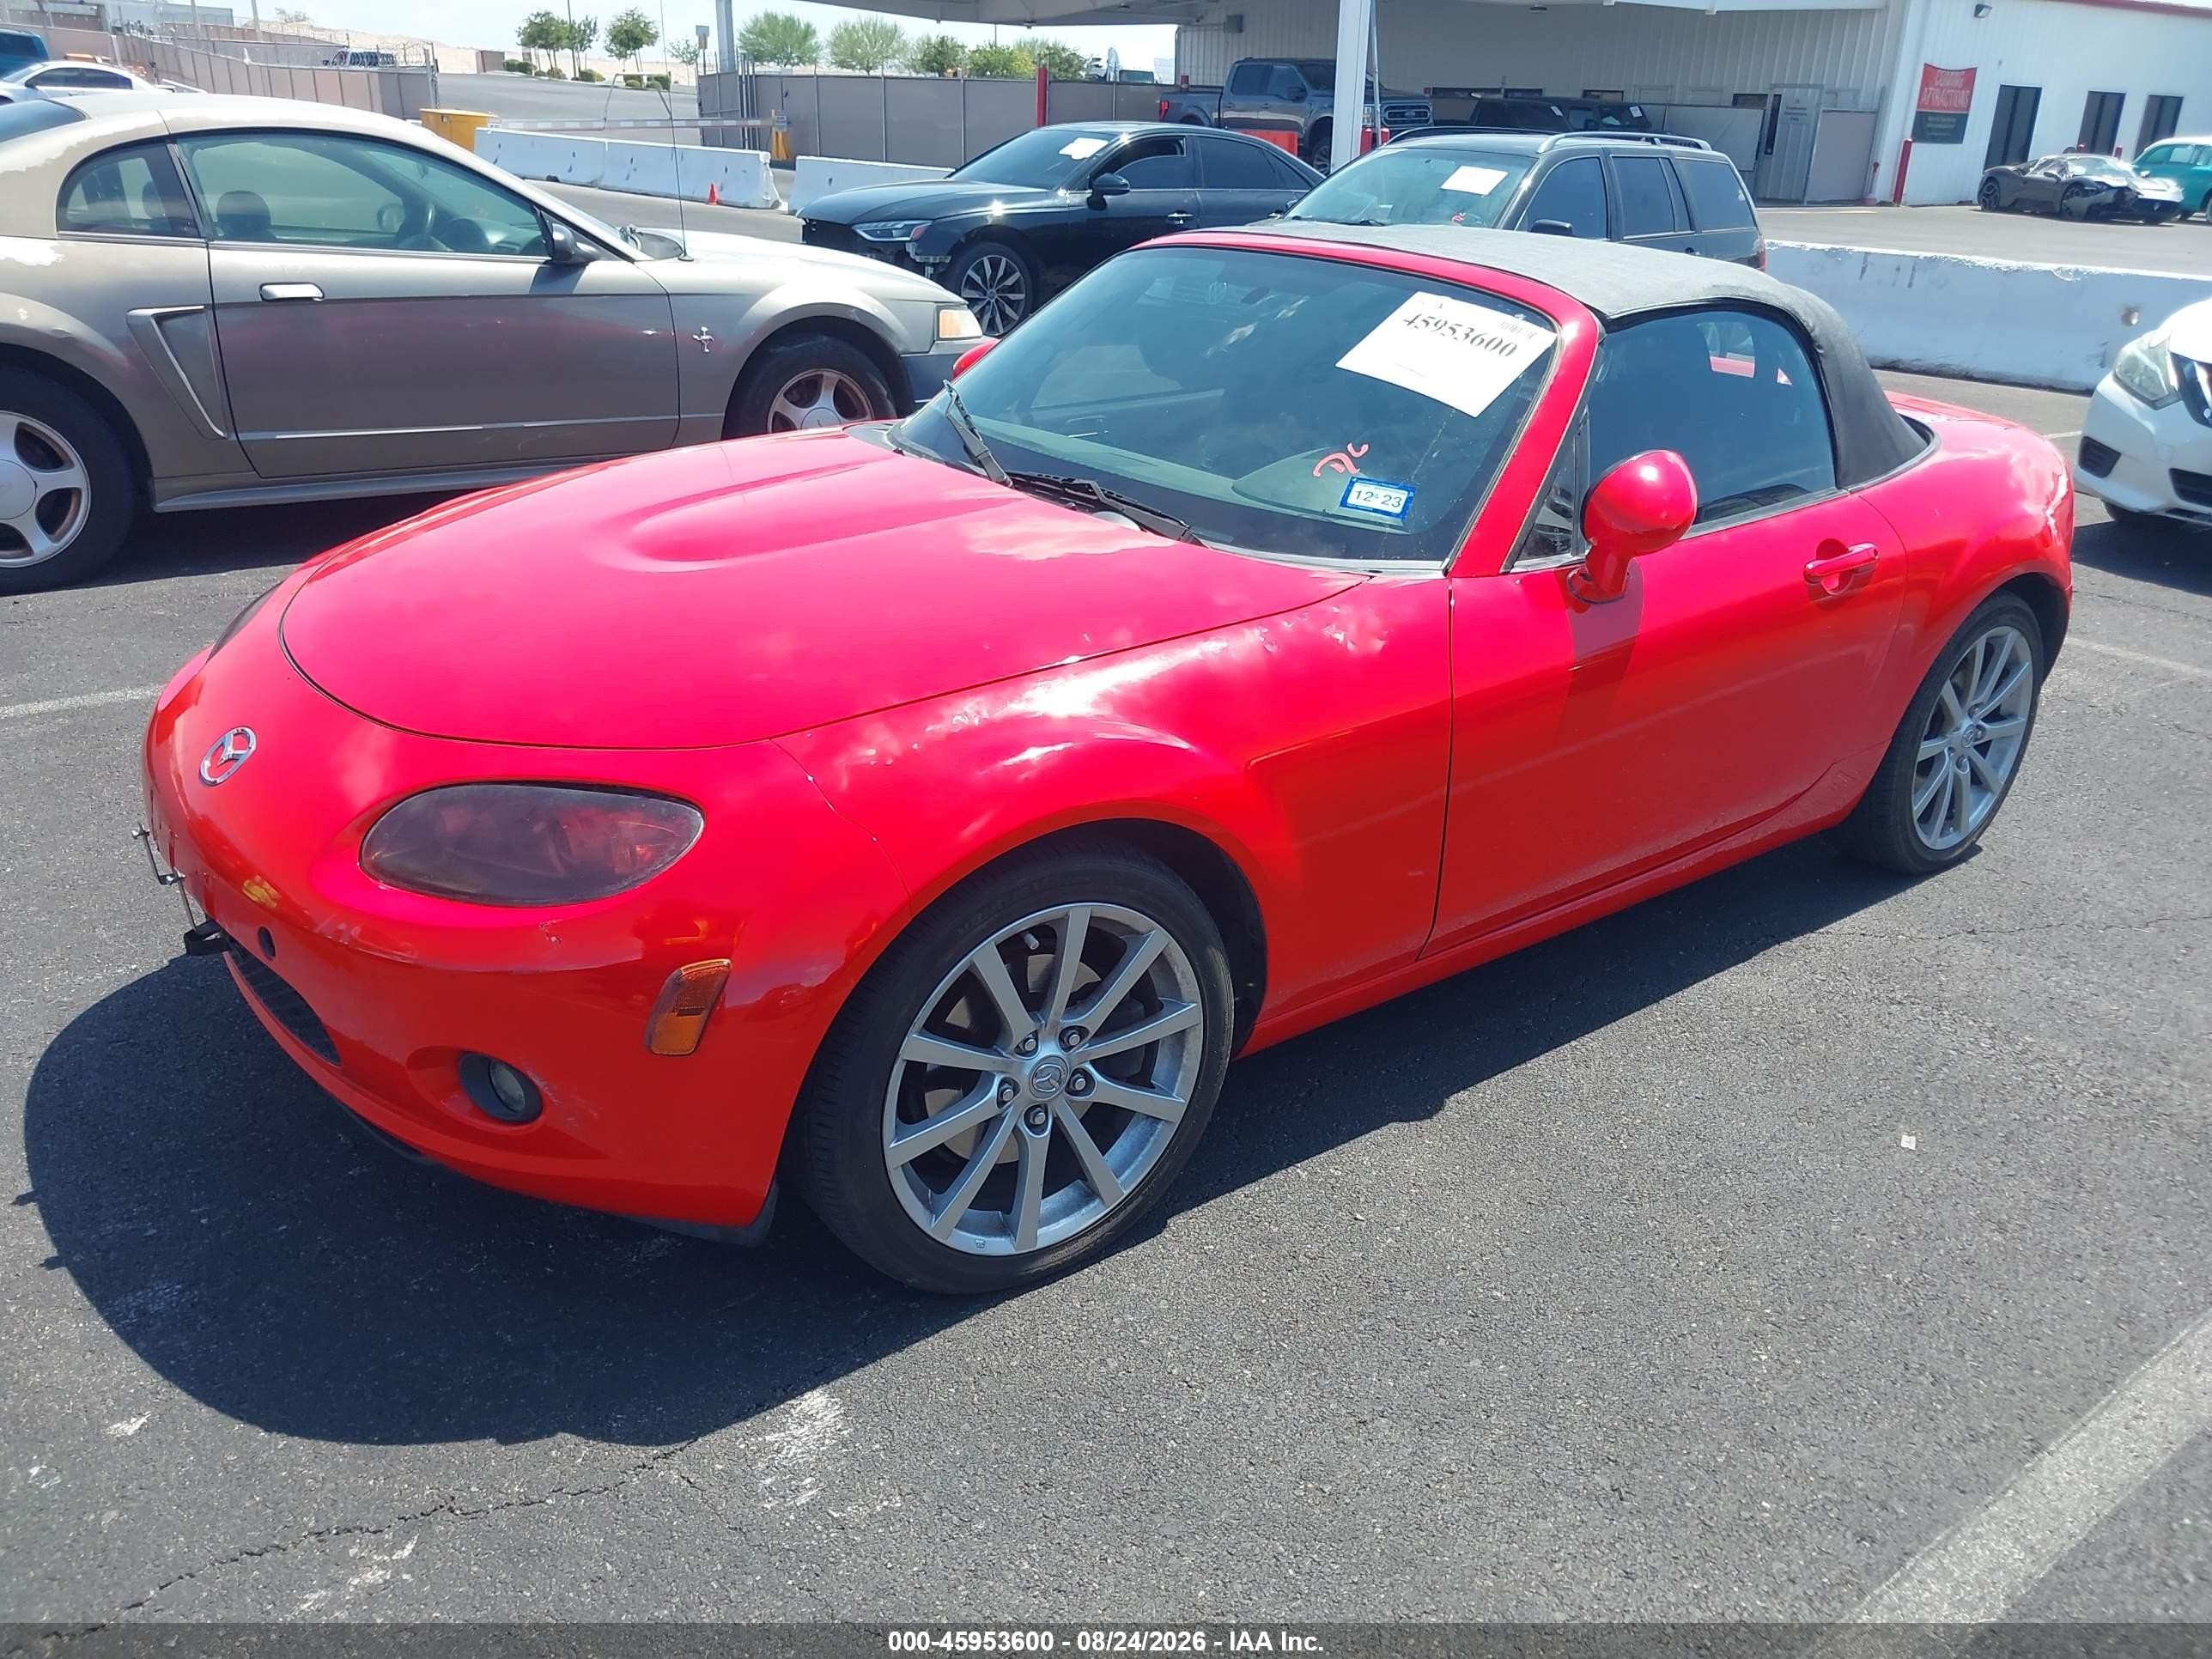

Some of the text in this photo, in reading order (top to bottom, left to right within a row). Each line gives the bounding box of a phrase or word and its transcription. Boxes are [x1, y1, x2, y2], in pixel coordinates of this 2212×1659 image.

[1935, 70, 1966, 88] COMING
[1920, 87, 1970, 108] ATTRACTIONS
[1402, 313, 1518, 357] 45953600
